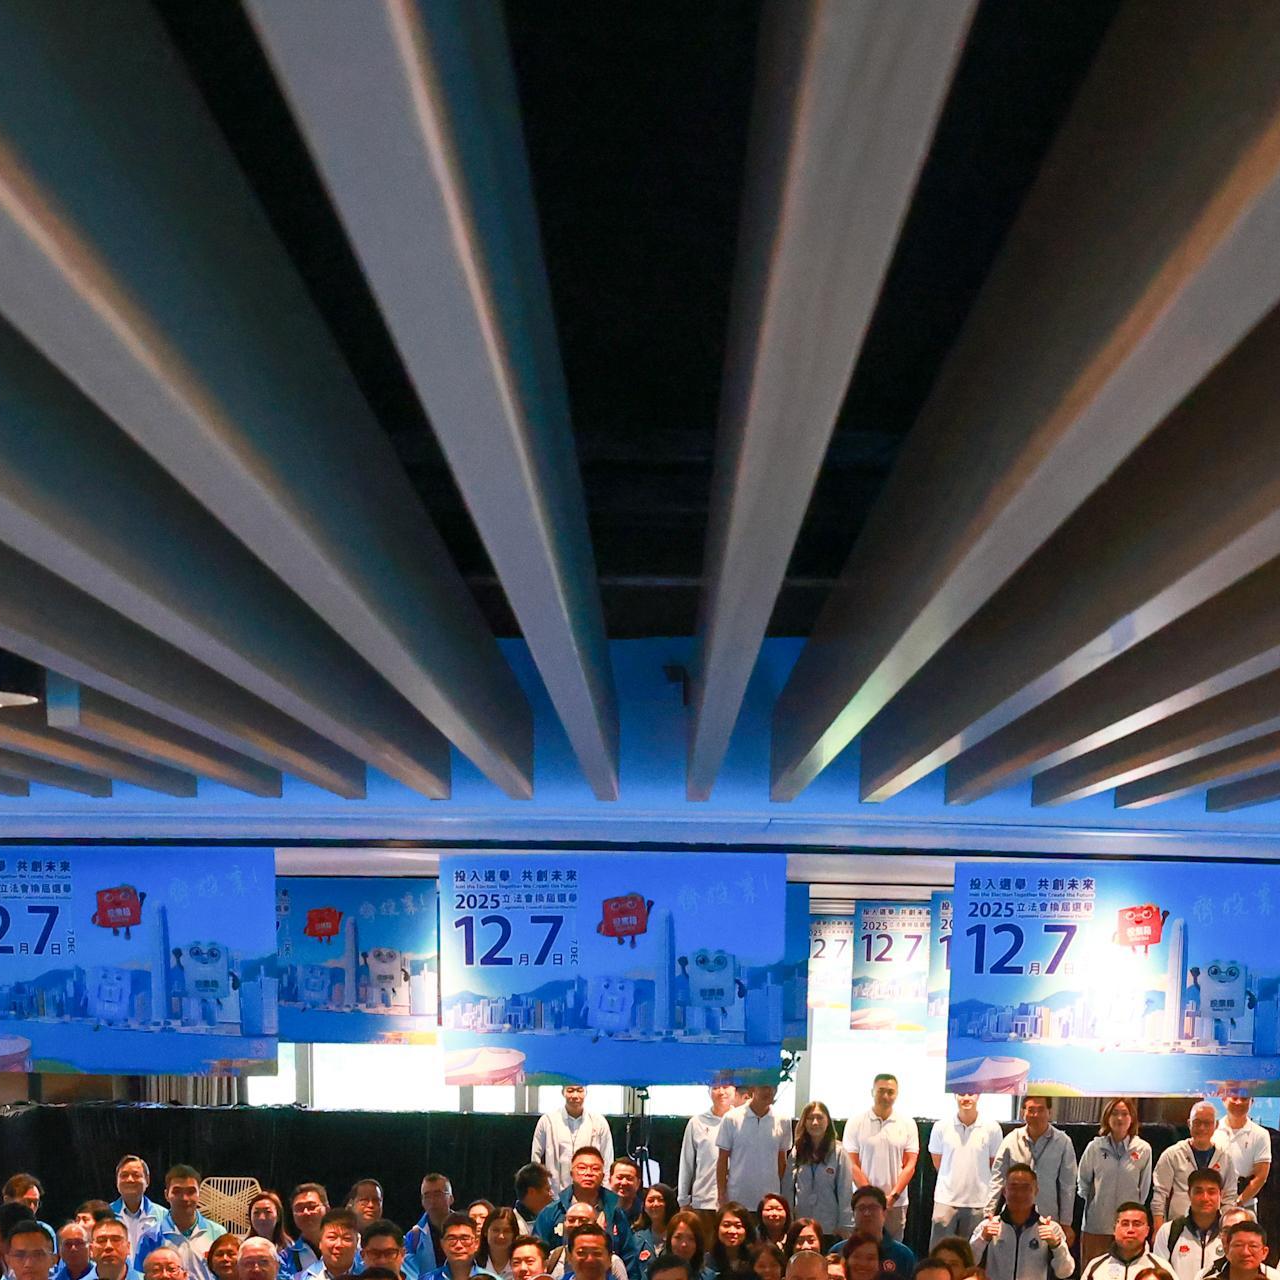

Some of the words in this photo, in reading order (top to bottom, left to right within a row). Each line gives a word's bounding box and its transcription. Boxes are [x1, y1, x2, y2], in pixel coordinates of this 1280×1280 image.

[969, 878, 1026, 890] 投入選舉
[1038, 878, 1094, 890] 共創未來
[455, 894, 500, 909] 2025
[968, 902, 1014, 918] 2025
[862, 921, 888, 931] 2025
[454, 915, 563, 966] 12月7日
